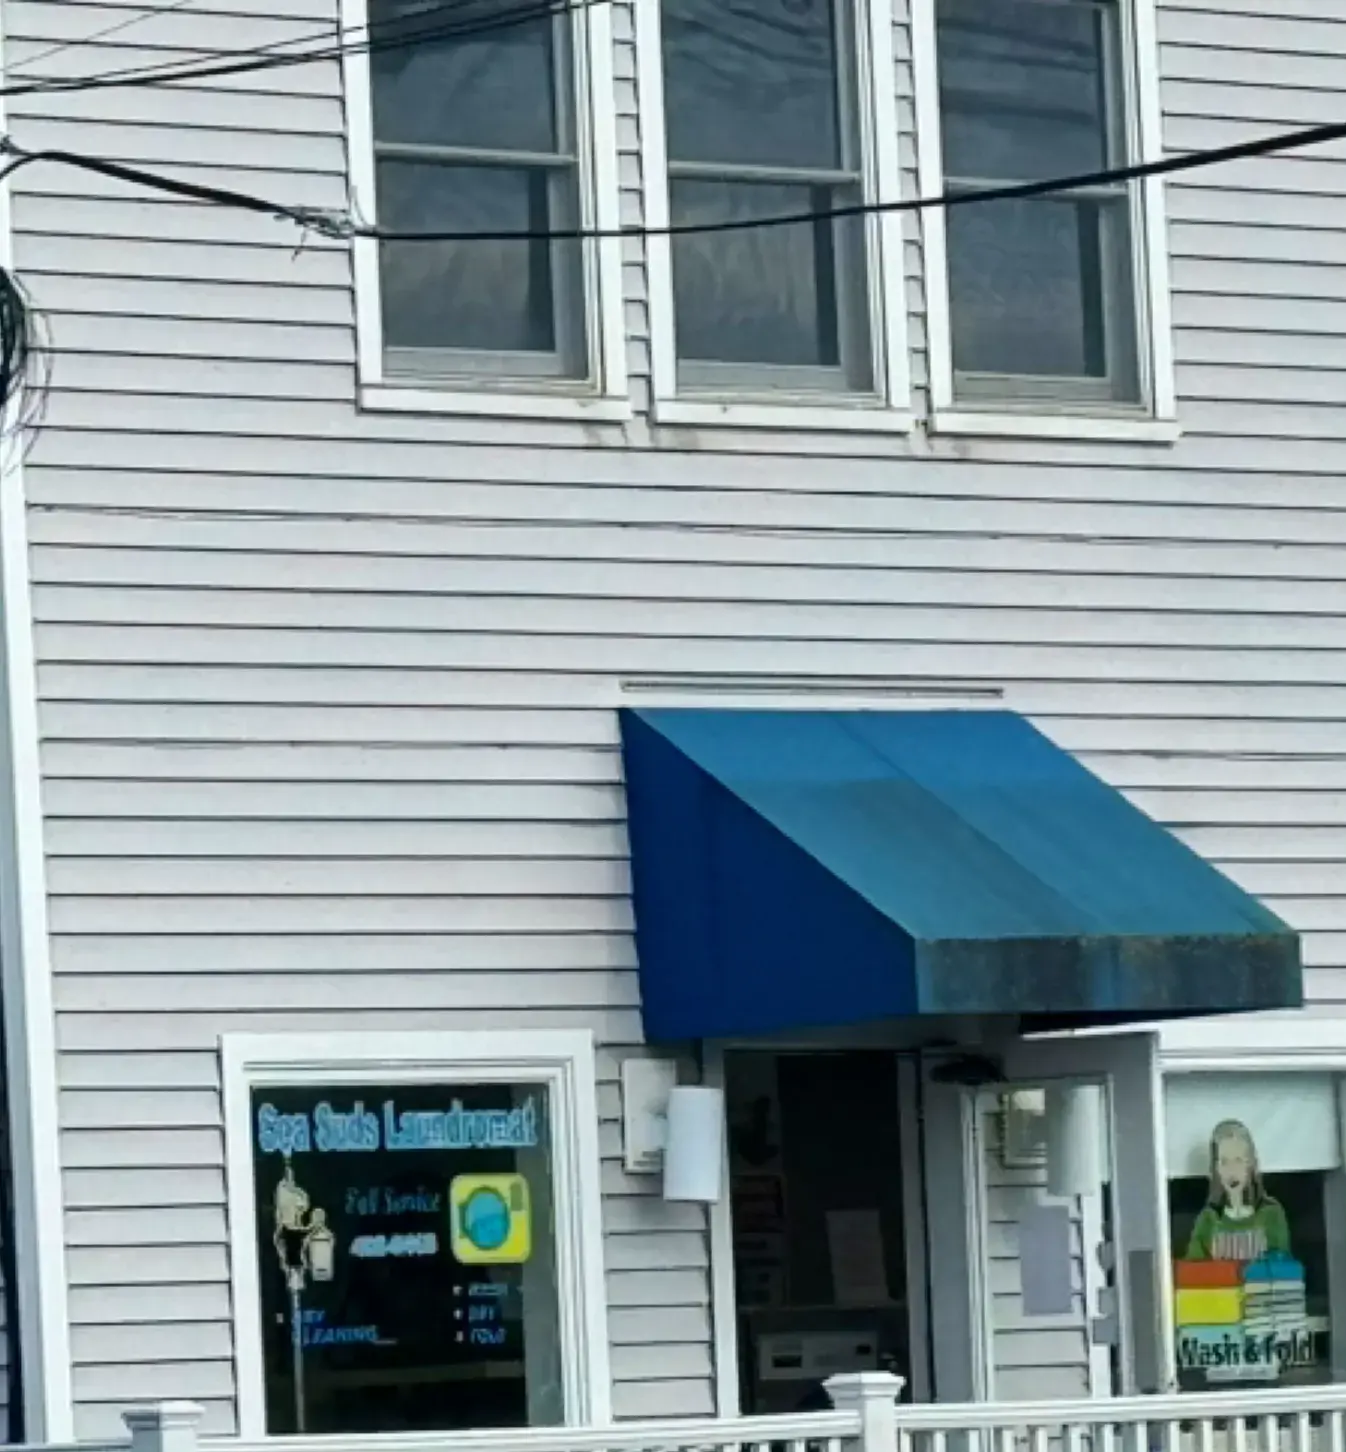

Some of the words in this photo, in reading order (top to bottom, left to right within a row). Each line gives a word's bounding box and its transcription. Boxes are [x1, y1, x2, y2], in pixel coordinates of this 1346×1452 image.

[314, 1101, 379, 1151] Suds
[384, 1097, 538, 1149] Laundromat
[1178, 1333, 1240, 1366] Wash
